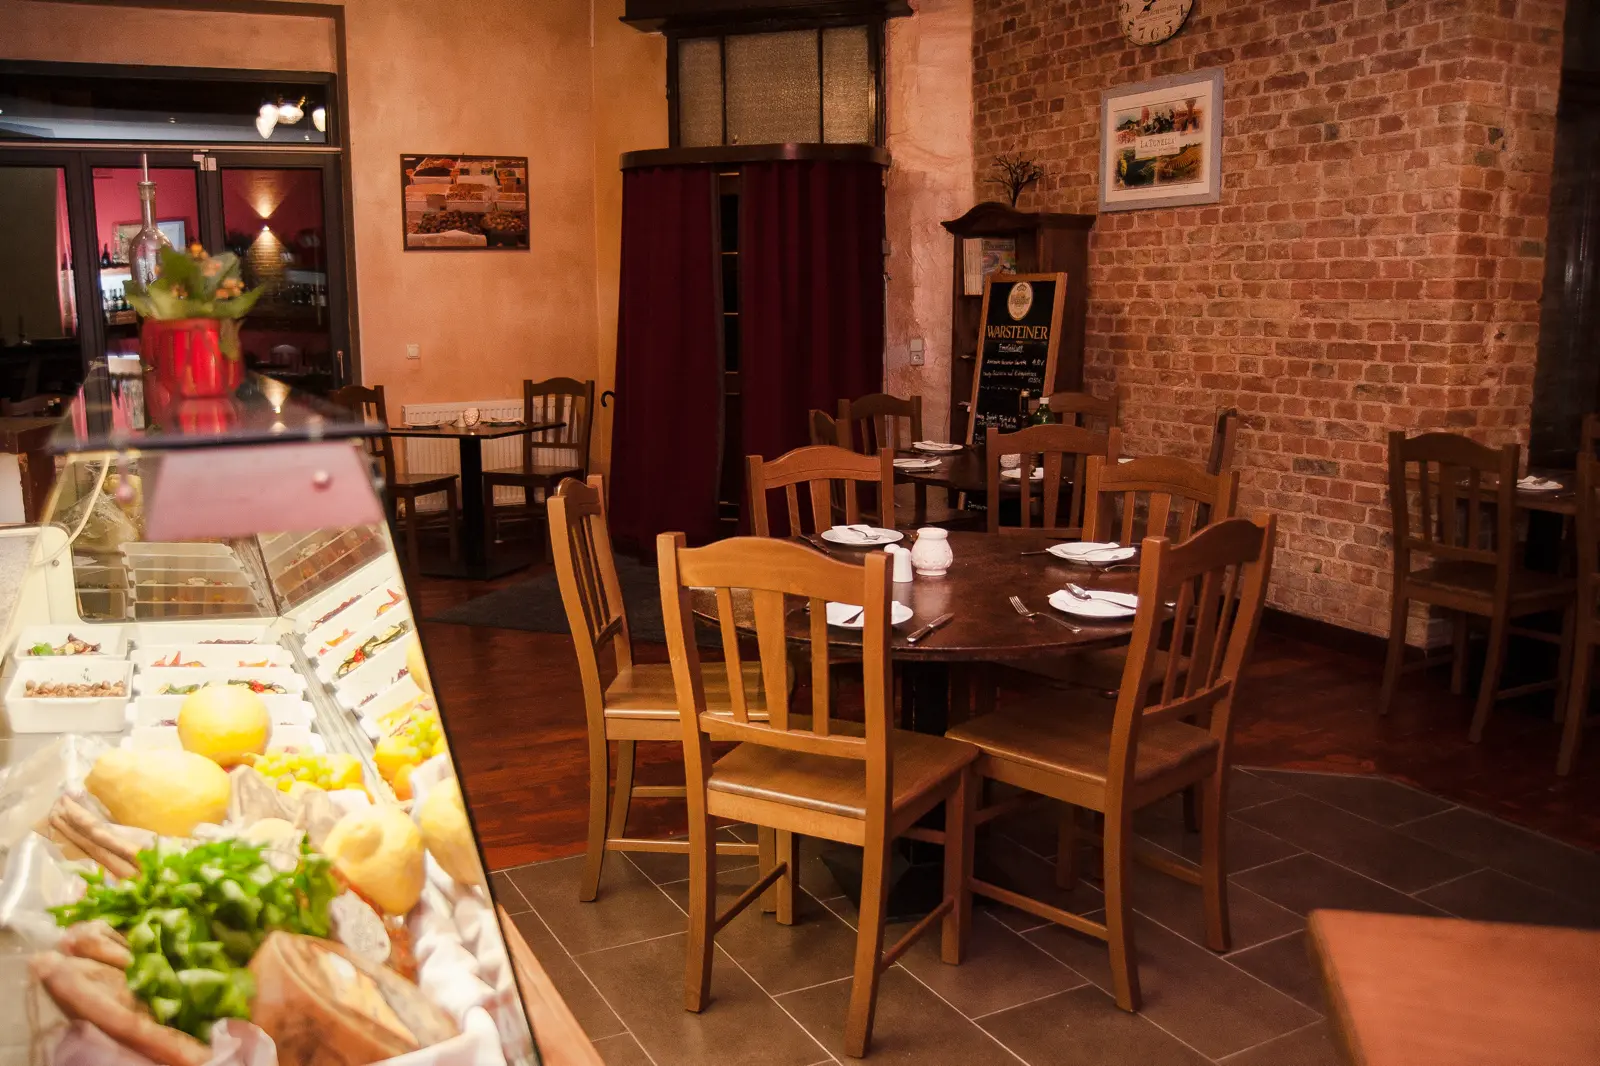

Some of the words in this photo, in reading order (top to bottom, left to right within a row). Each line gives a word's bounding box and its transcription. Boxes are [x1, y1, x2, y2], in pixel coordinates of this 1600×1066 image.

[1138, 26, 1146, 39] 7
[1150, 27, 1160, 40] 6
[987, 325, 1048, 340] WARSTEINER
